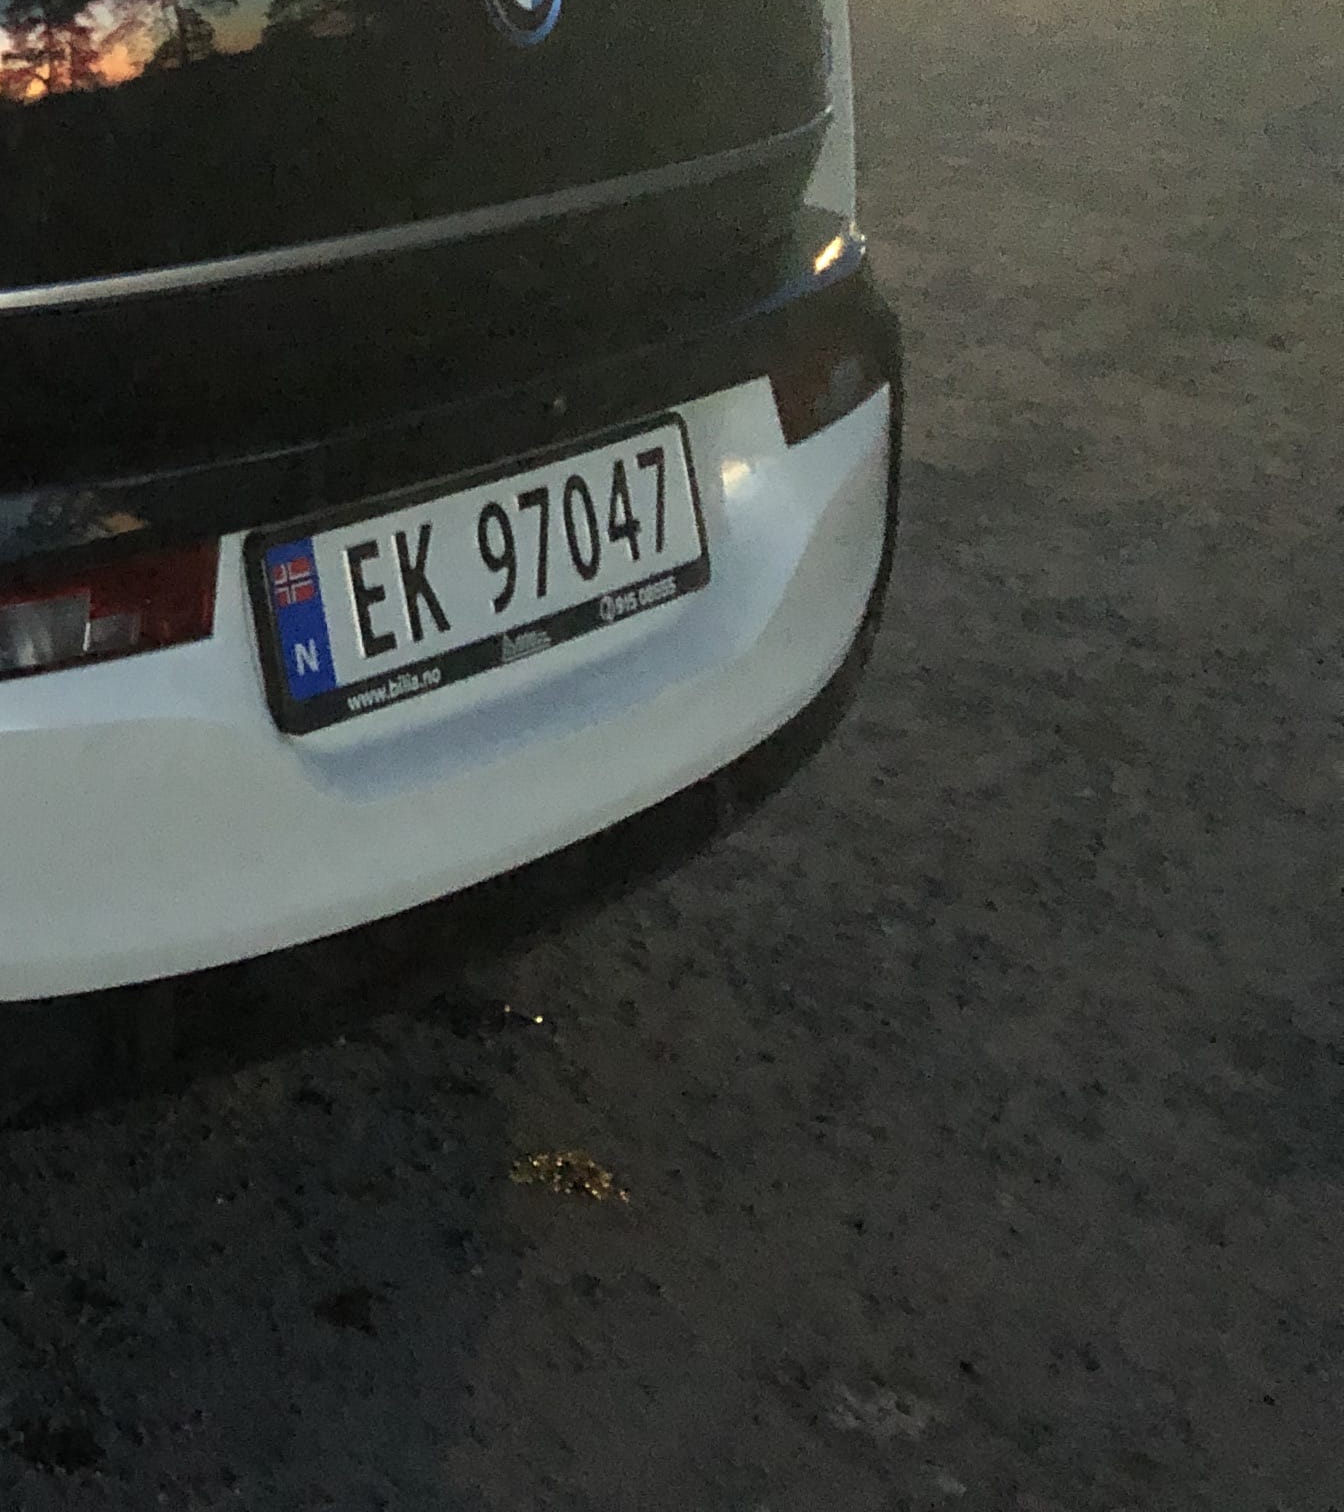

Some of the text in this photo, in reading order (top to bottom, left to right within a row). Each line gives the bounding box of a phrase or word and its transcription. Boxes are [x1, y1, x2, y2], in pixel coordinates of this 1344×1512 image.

[345, 446, 665, 659] EK 97047
[294, 638, 320, 676] N
